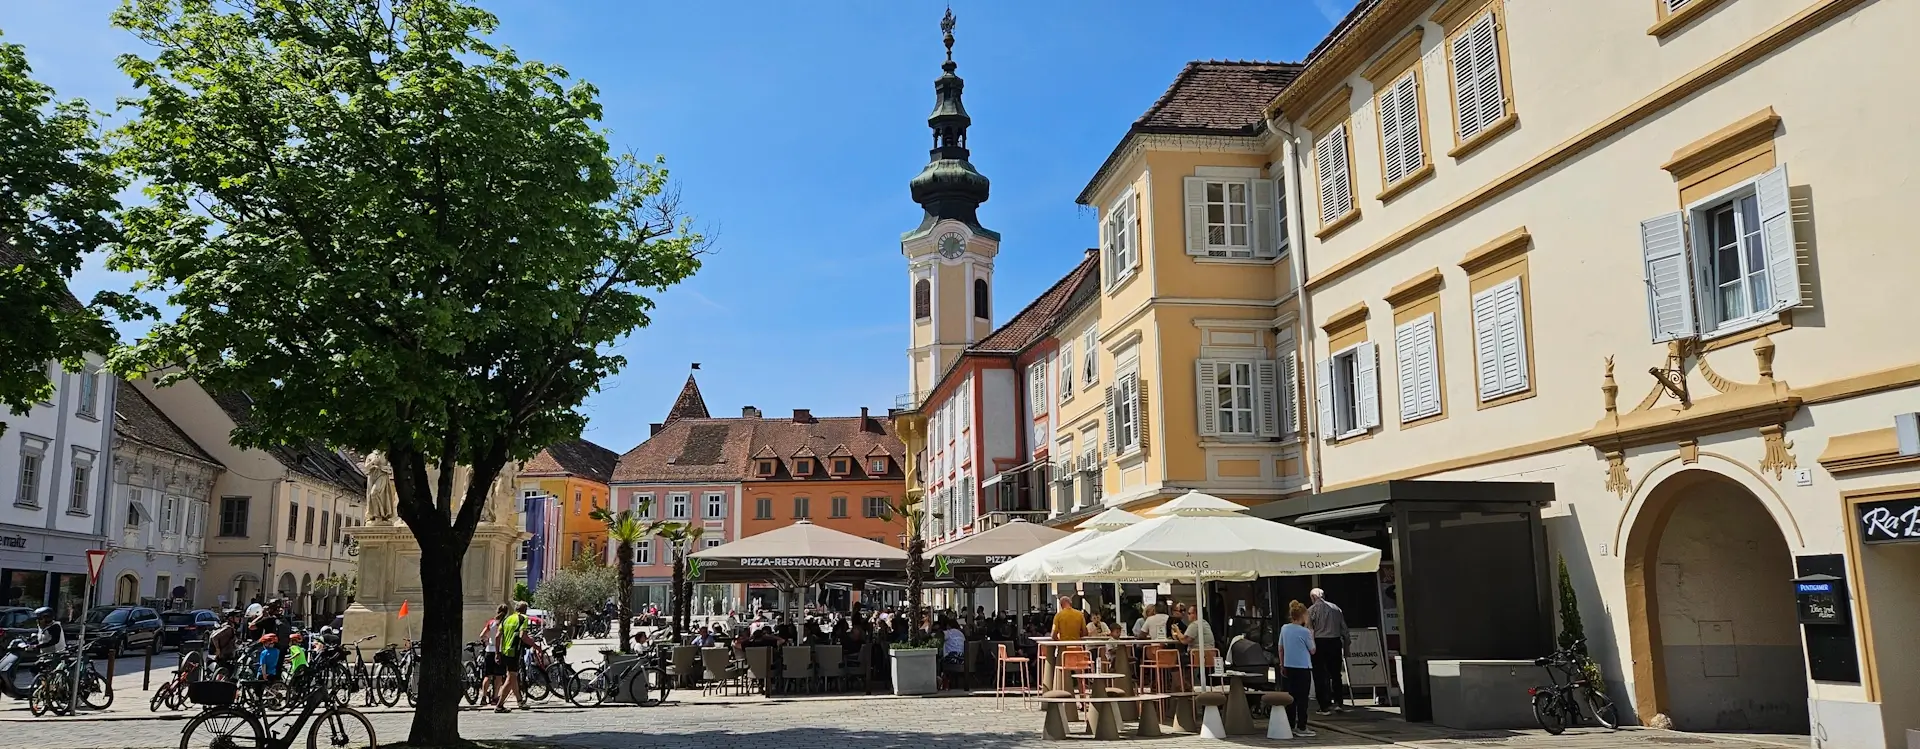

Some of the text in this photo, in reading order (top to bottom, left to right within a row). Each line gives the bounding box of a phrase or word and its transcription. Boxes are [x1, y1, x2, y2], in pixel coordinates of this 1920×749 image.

[740, 557, 881, 568] PIZZA-RESTAURANT & CAFÉ
[1169, 560, 1209, 569] HORNIG
[1299, 560, 1340, 569] HORNIG
